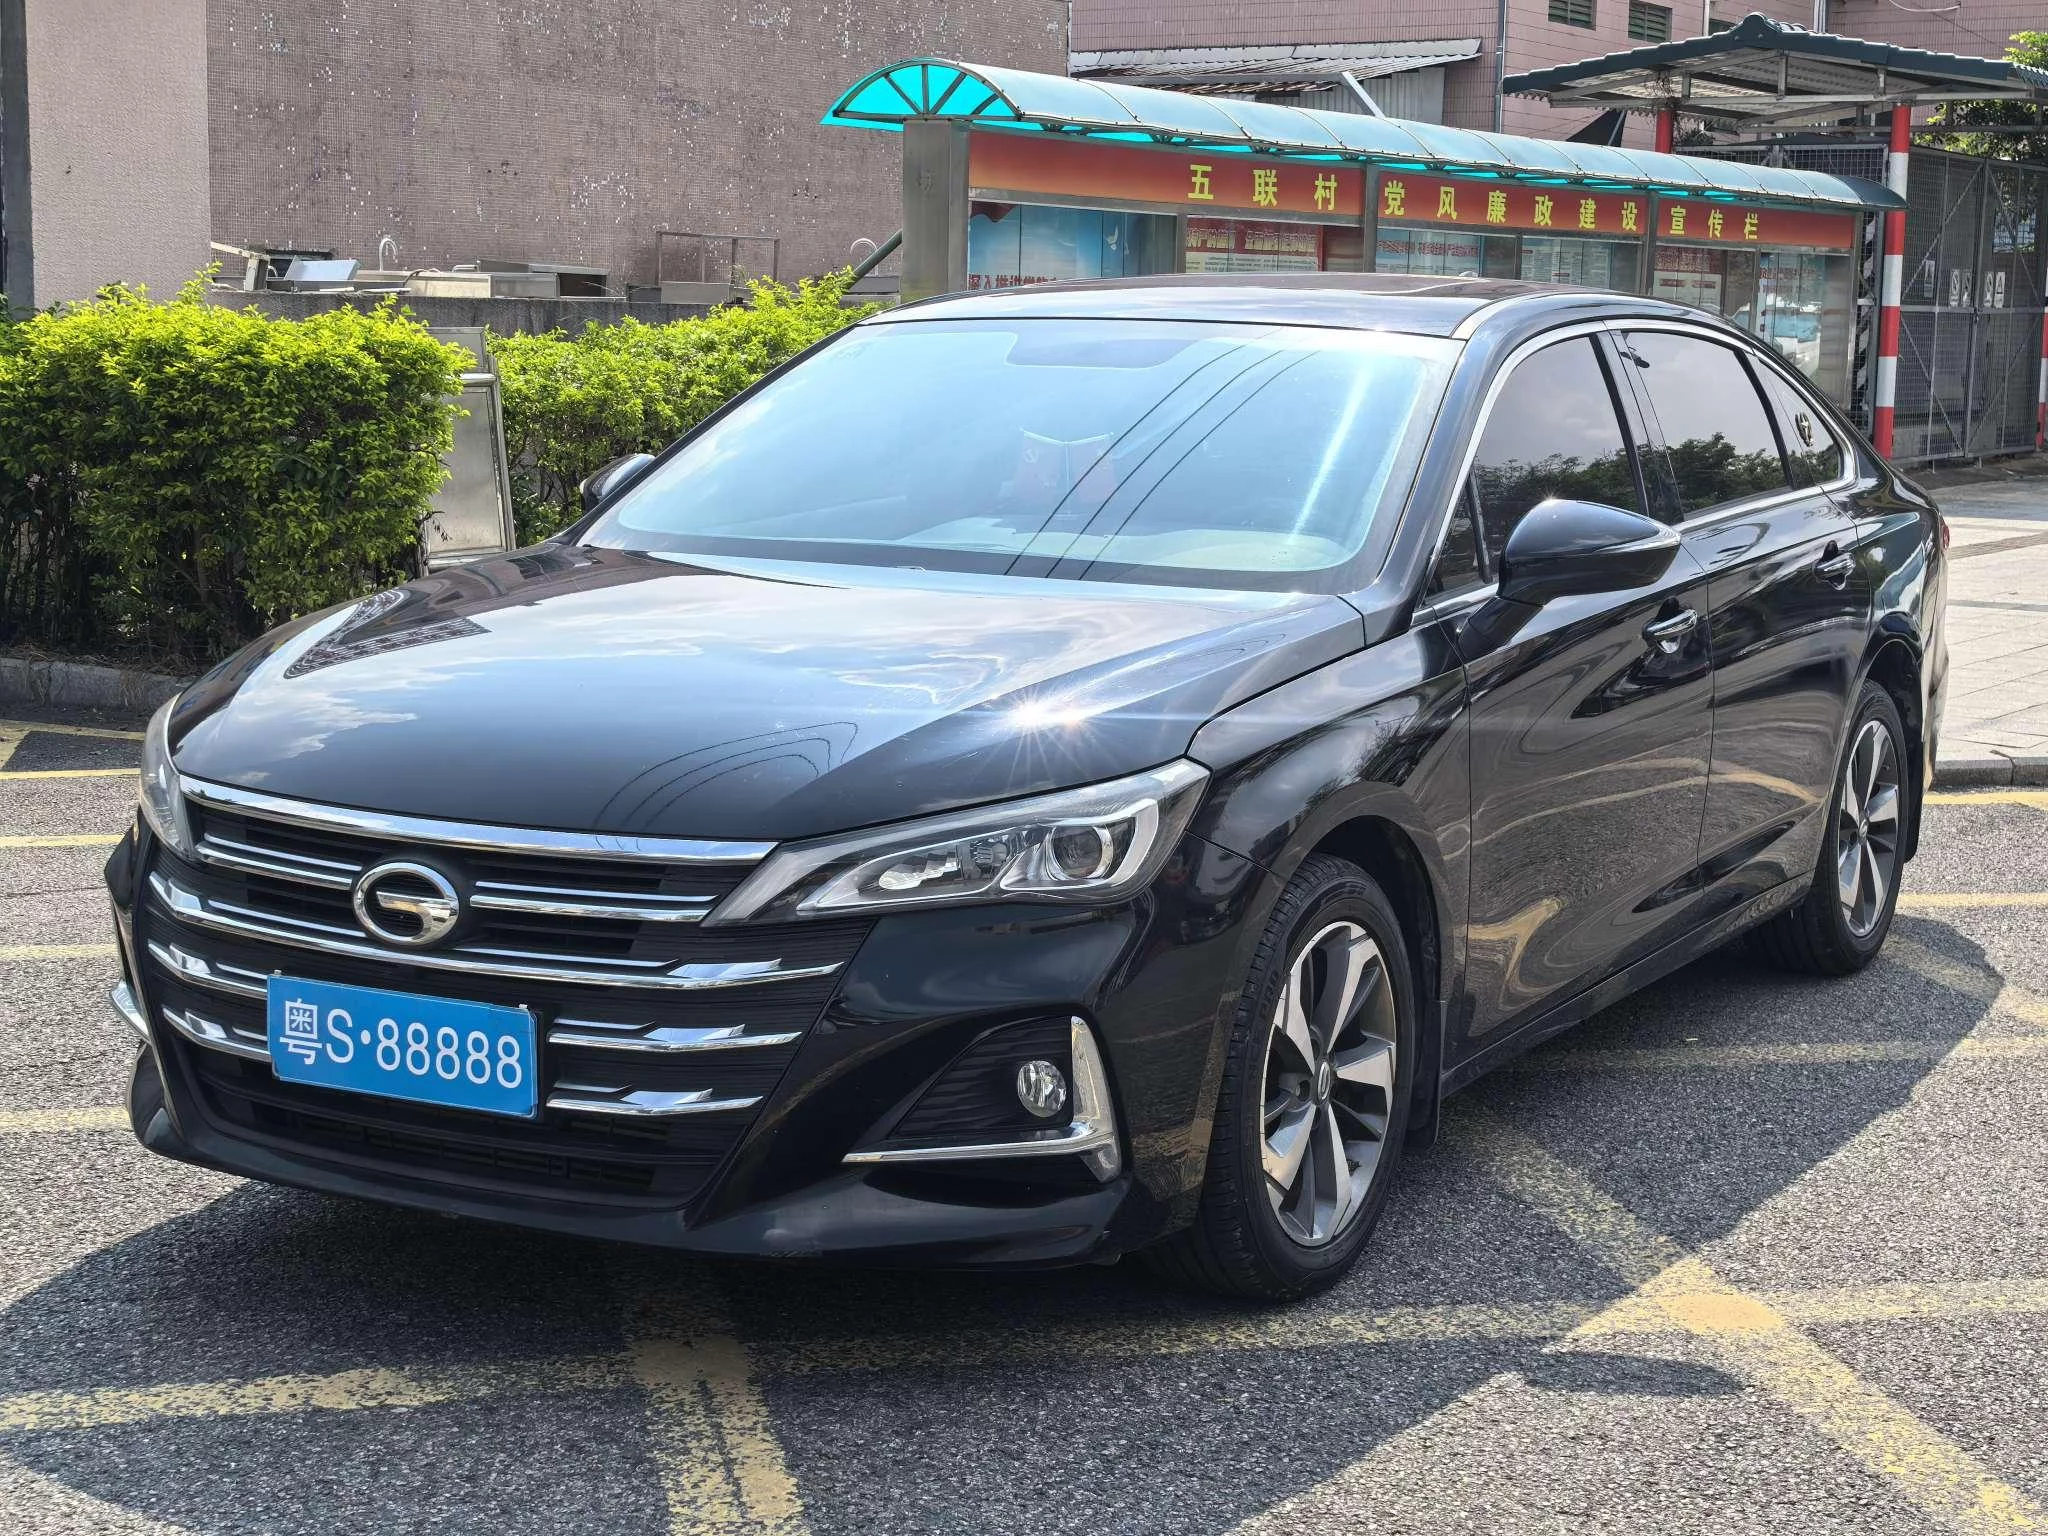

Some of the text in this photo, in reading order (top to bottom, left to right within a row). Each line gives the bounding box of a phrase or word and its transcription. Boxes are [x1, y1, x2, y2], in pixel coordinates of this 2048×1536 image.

[1187, 163, 1761, 241] 五联村 党风廉政建设 宣传栏
